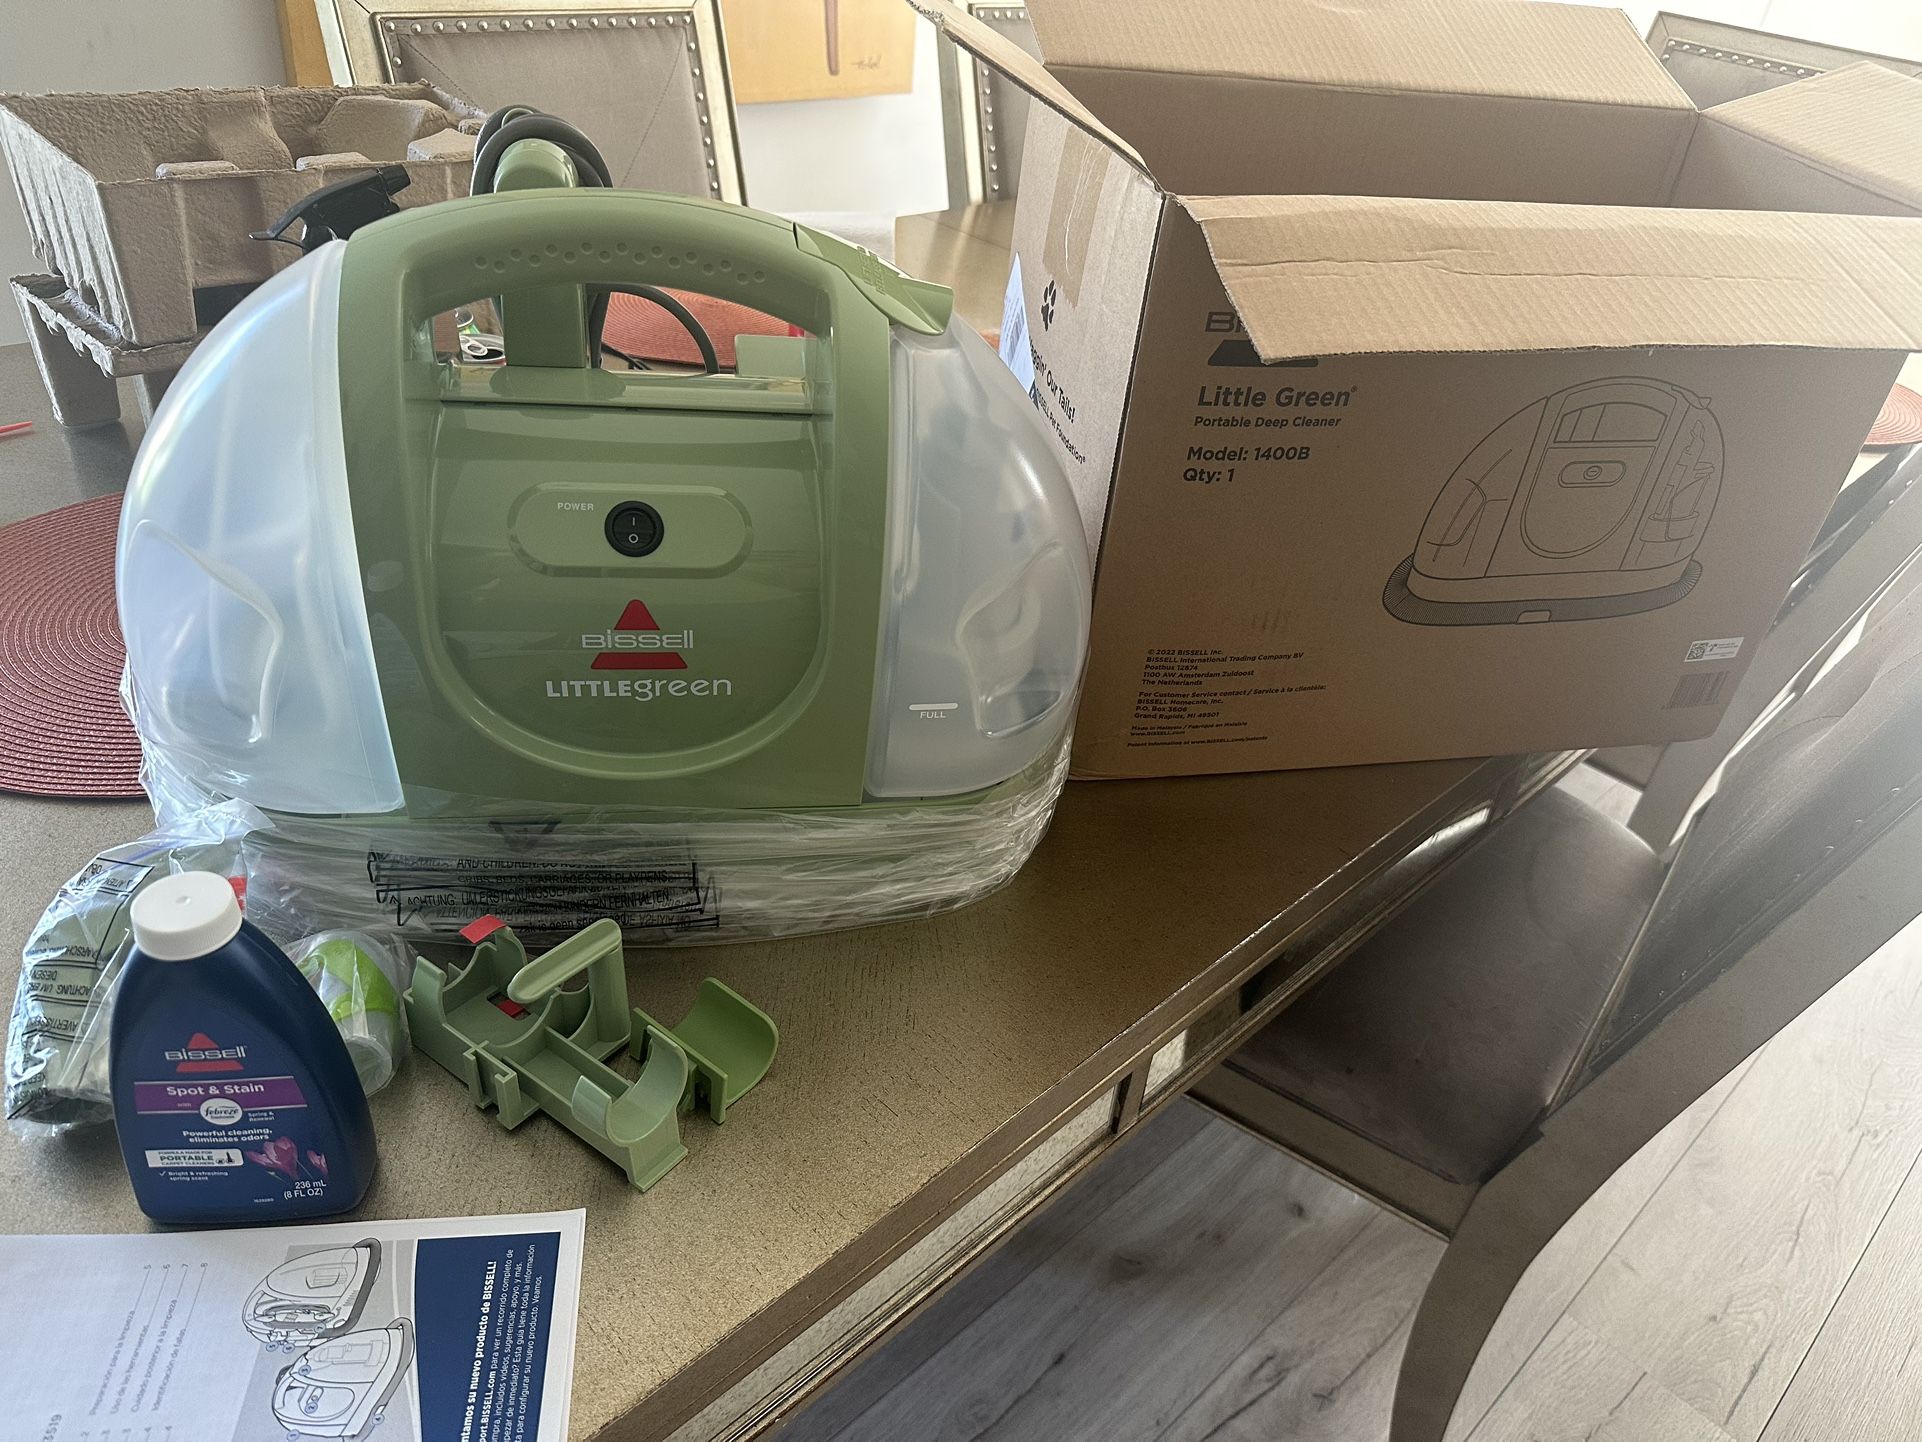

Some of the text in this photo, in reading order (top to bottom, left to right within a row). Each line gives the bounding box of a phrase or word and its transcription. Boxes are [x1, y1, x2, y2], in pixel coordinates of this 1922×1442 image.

[1047, 370, 1075, 423] Our Tails!
[1198, 385, 1267, 408] Little
[1194, 416, 1341, 429] Portable Deep Cleaner
[1187, 446, 1310, 461] Model: 1400B
[1183, 468, 1235, 484] Qty: 1
[557, 502, 594, 511] POWER
[166, 1083, 264, 1097] Spot & Stain
[203, 1106, 239, 1119] febreze
[182, 1129, 225, 1137] Powerful
[241, 1134, 269, 1142] odors
[295, 1179, 327, 1189] 236 mL
[284, 1188, 323, 1200] (8 FL OZ)
[506, 1249, 514, 1258] de
[522, 1244, 536, 1284] información
[482, 1260, 497, 1300] BISSELL!
[501, 1259, 513, 1292] completo
[510, 1285, 520, 1308] apoyo,
[520, 1292, 530, 1309] toda
[481, 1301, 491, 1313] de
[494, 1293, 507, 1325] recorrido
[518, 1310, 528, 1328] tiene
[475, 1315, 490, 1358] producto
[495, 1327, 502, 1336] un
[504, 1309, 517, 1353] sugerencias,
[490, 1351, 500, 1369] para
[513, 1346, 523, 1362] Esta
[517, 1275, 543, 1433] para configurar su nuevo producto. Veamos.
[469, 1360, 482, 1390] nuevo
[508, 1364, 520, 1405] inmediato?
[468, 1391, 477, 1403] su
[494, 1383, 507, 1416] incluidos
[506, 1407, 514, 1417] de
